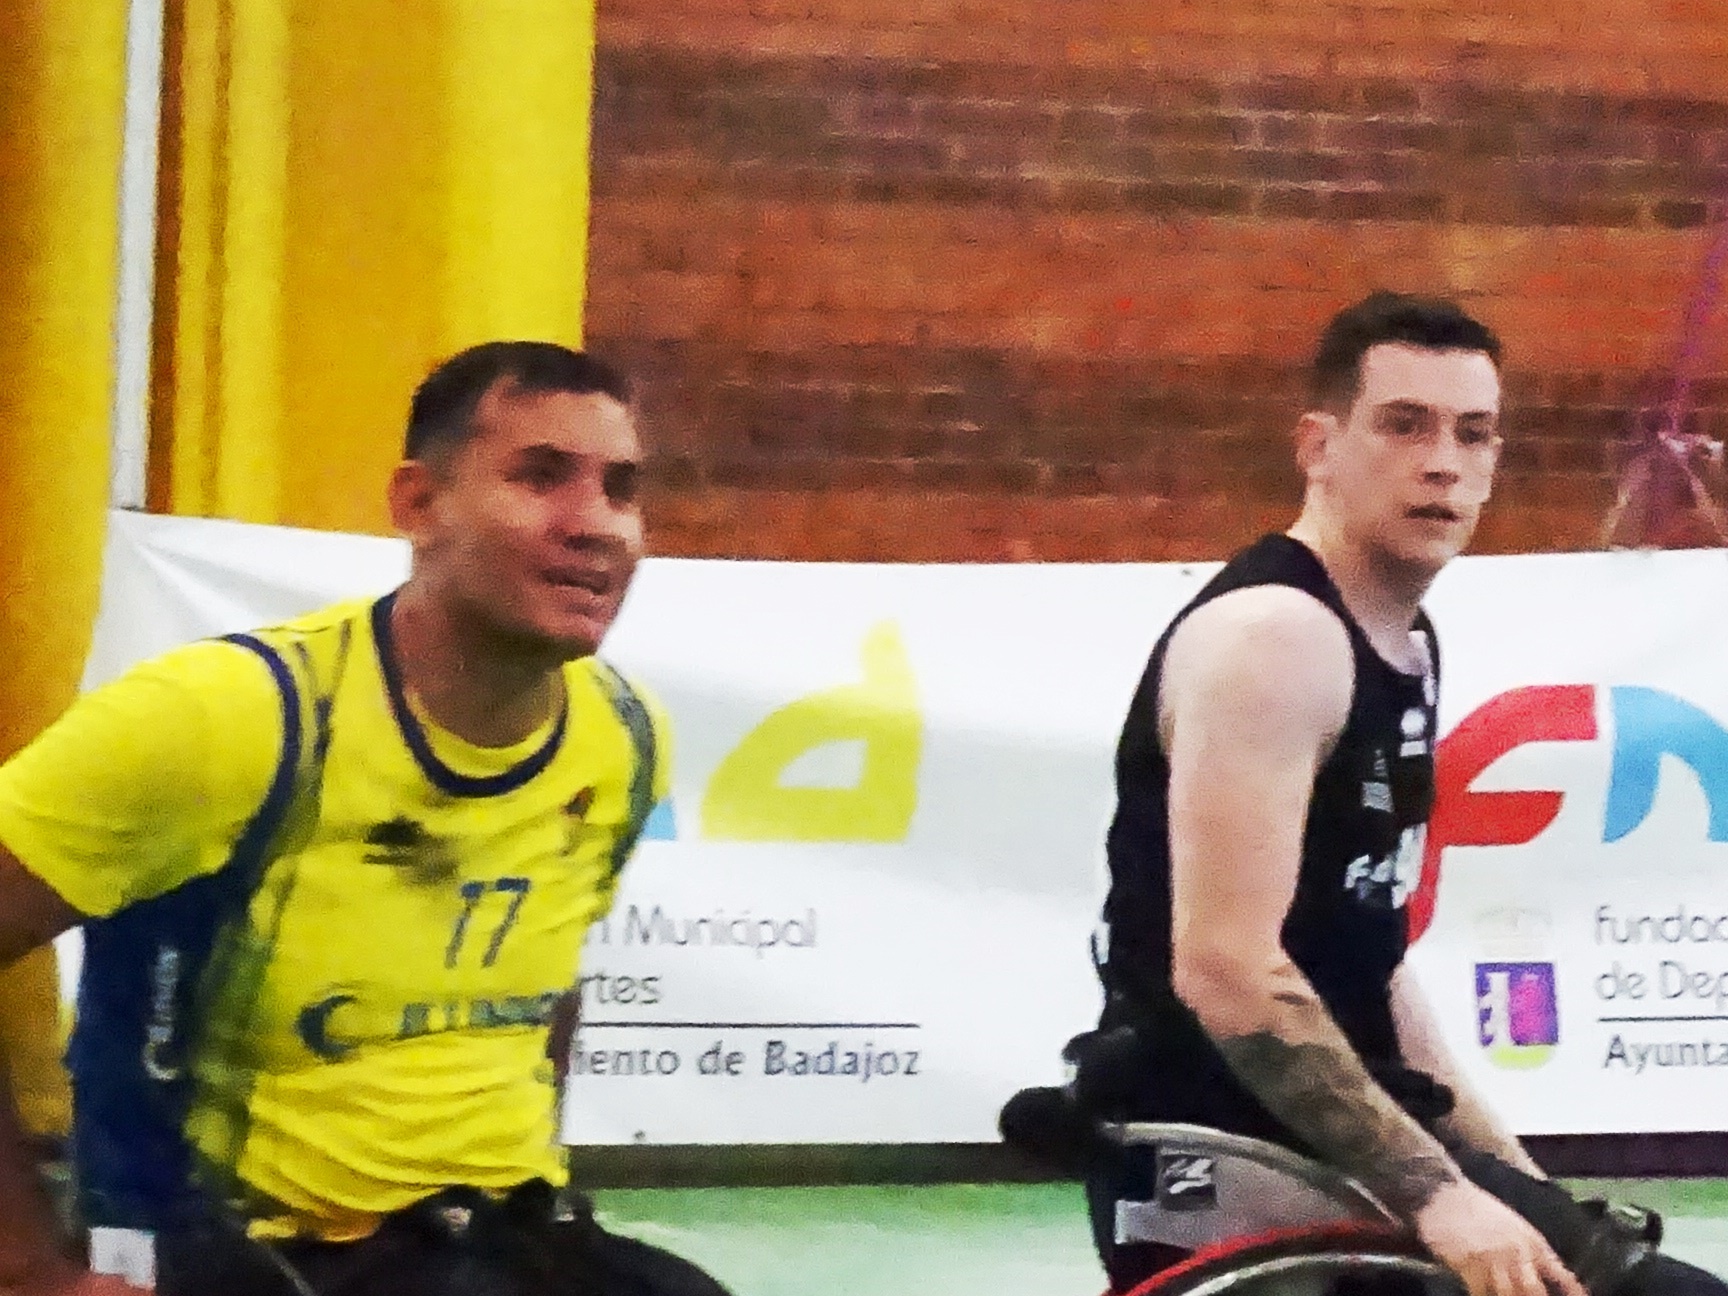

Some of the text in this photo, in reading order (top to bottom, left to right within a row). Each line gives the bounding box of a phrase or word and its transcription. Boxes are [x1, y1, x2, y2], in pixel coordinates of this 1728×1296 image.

[444, 877, 530, 970] 77
[624, 904, 818, 959] Municipal
[578, 976, 662, 1005] rtes
[1597, 960, 1646, 1000] de
[696, 1040, 748, 1076] de
[763, 1038, 922, 1083] Badajoz
